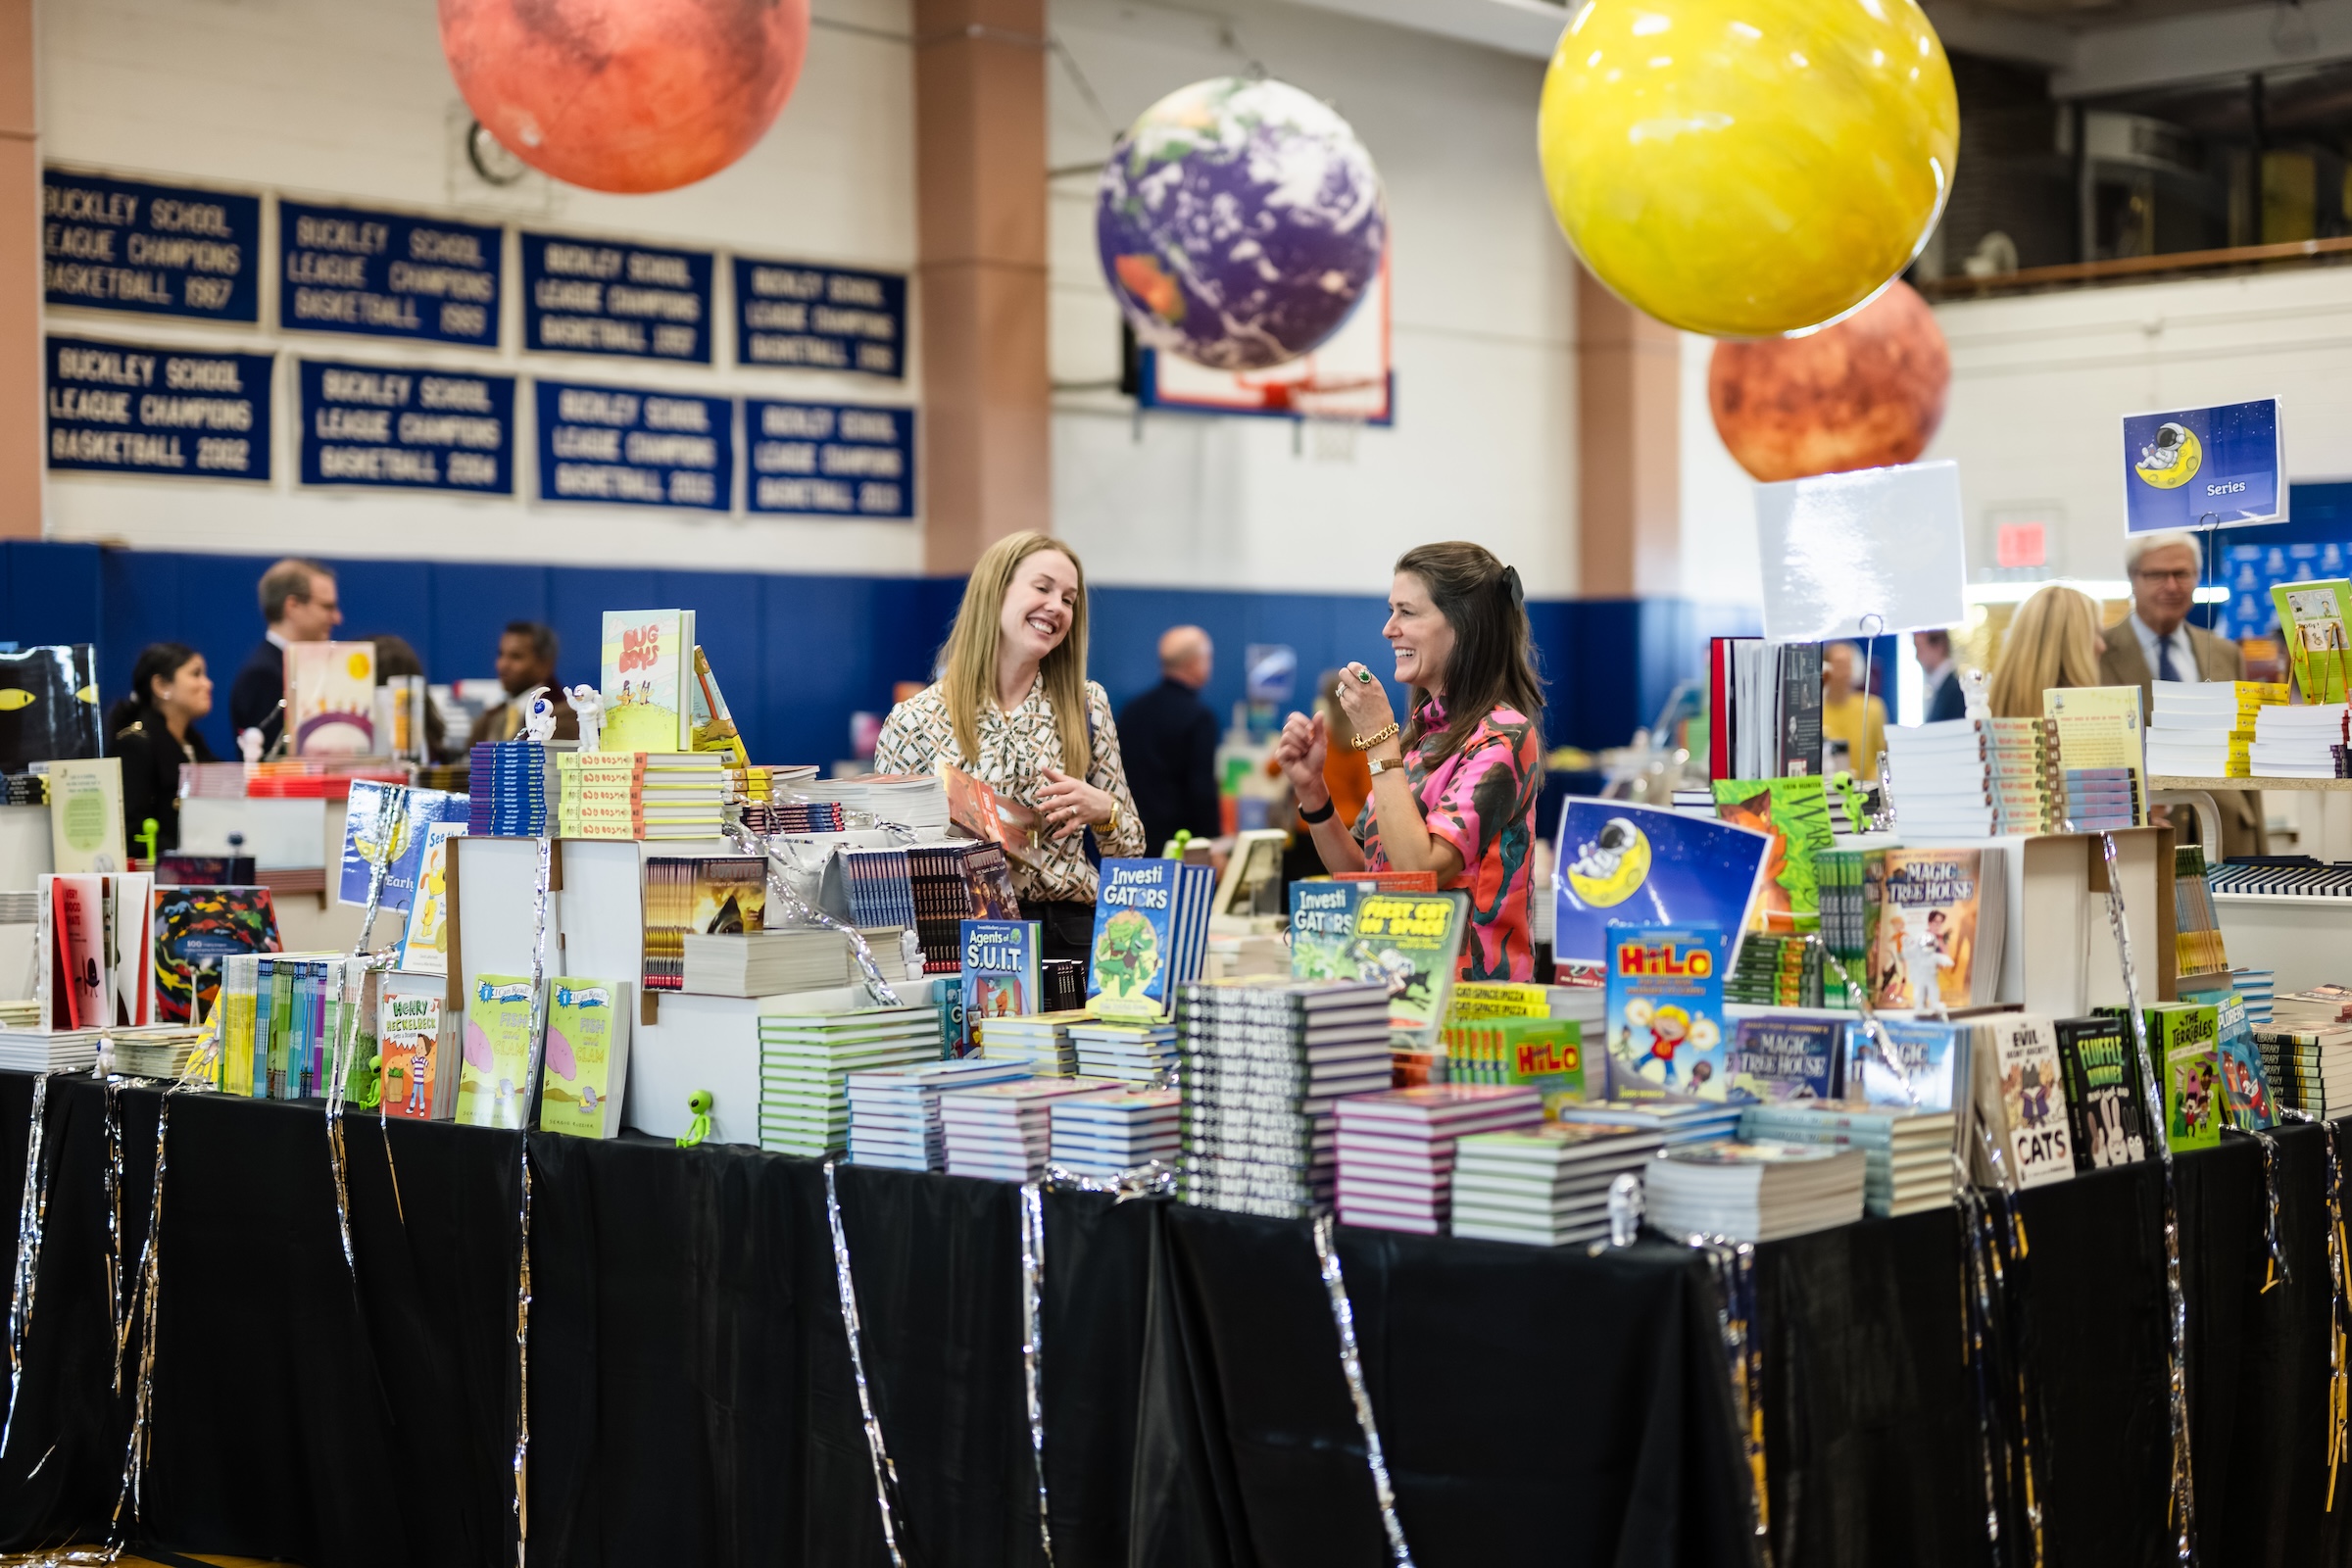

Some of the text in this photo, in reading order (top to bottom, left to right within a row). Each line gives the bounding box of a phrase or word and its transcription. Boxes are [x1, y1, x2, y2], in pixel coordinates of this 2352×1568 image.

[45, 185, 233, 238] BUCKLEY SCHOOL
[45, 223, 241, 275] EAGUE CHAMPIONS
[45, 261, 173, 305] BASKETBALL
[58, 347, 243, 393] BUCKLEY SCHOOL
[50, 387, 253, 432] LEAGUE CHAMPIONS
[52, 427, 186, 467] BASKETBALL
[2207, 480, 2246, 497] Series
[623, 624, 660, 652] BUG
[619, 645, 660, 673] BOYS
[429, 833, 445, 847] See
[967, 849, 1001, 869] SURVIVED
[710, 863, 763, 879] SURVIVED
[1112, 865, 1163, 885] Investi
[1906, 861, 1958, 882] MAGIC
[386, 875, 415, 893] Early
[1888, 882, 1925, 903] TREE
[1925, 880, 1975, 901] HOUSE
[1103, 885, 1168, 909] GATORS
[1299, 889, 1346, 909] Investi
[1362, 902, 1451, 919] FIRST CAT
[1389, 917, 1446, 936] SPACE
[969, 929, 1009, 948] Agents of
[967, 944, 1022, 971] S.U.I.T.
[484, 990, 489, 1000] 1
[564, 995, 567, 1004] 1
[387, 1017, 436, 1032] HECKELBECK
[500, 1012, 529, 1028] FISH
[580, 1018, 605, 1034] FISH
[2185, 1011, 2199, 1025] THE
[2219, 1004, 2245, 1030] PLORERS
[2013, 1029, 2038, 1047] EVIL
[2173, 1019, 2213, 1048] TERRIBLES
[2257, 1033, 2278, 1043] LIBRARY
[1761, 1034, 1811, 1055] MAGIC
[2078, 1036, 2125, 1071] FLUFFLE
[2259, 1045, 2279, 1054] LIBRARY
[1741, 1054, 1826, 1077] TREE HOUSE
[2018, 1130, 2066, 1164] CATS
